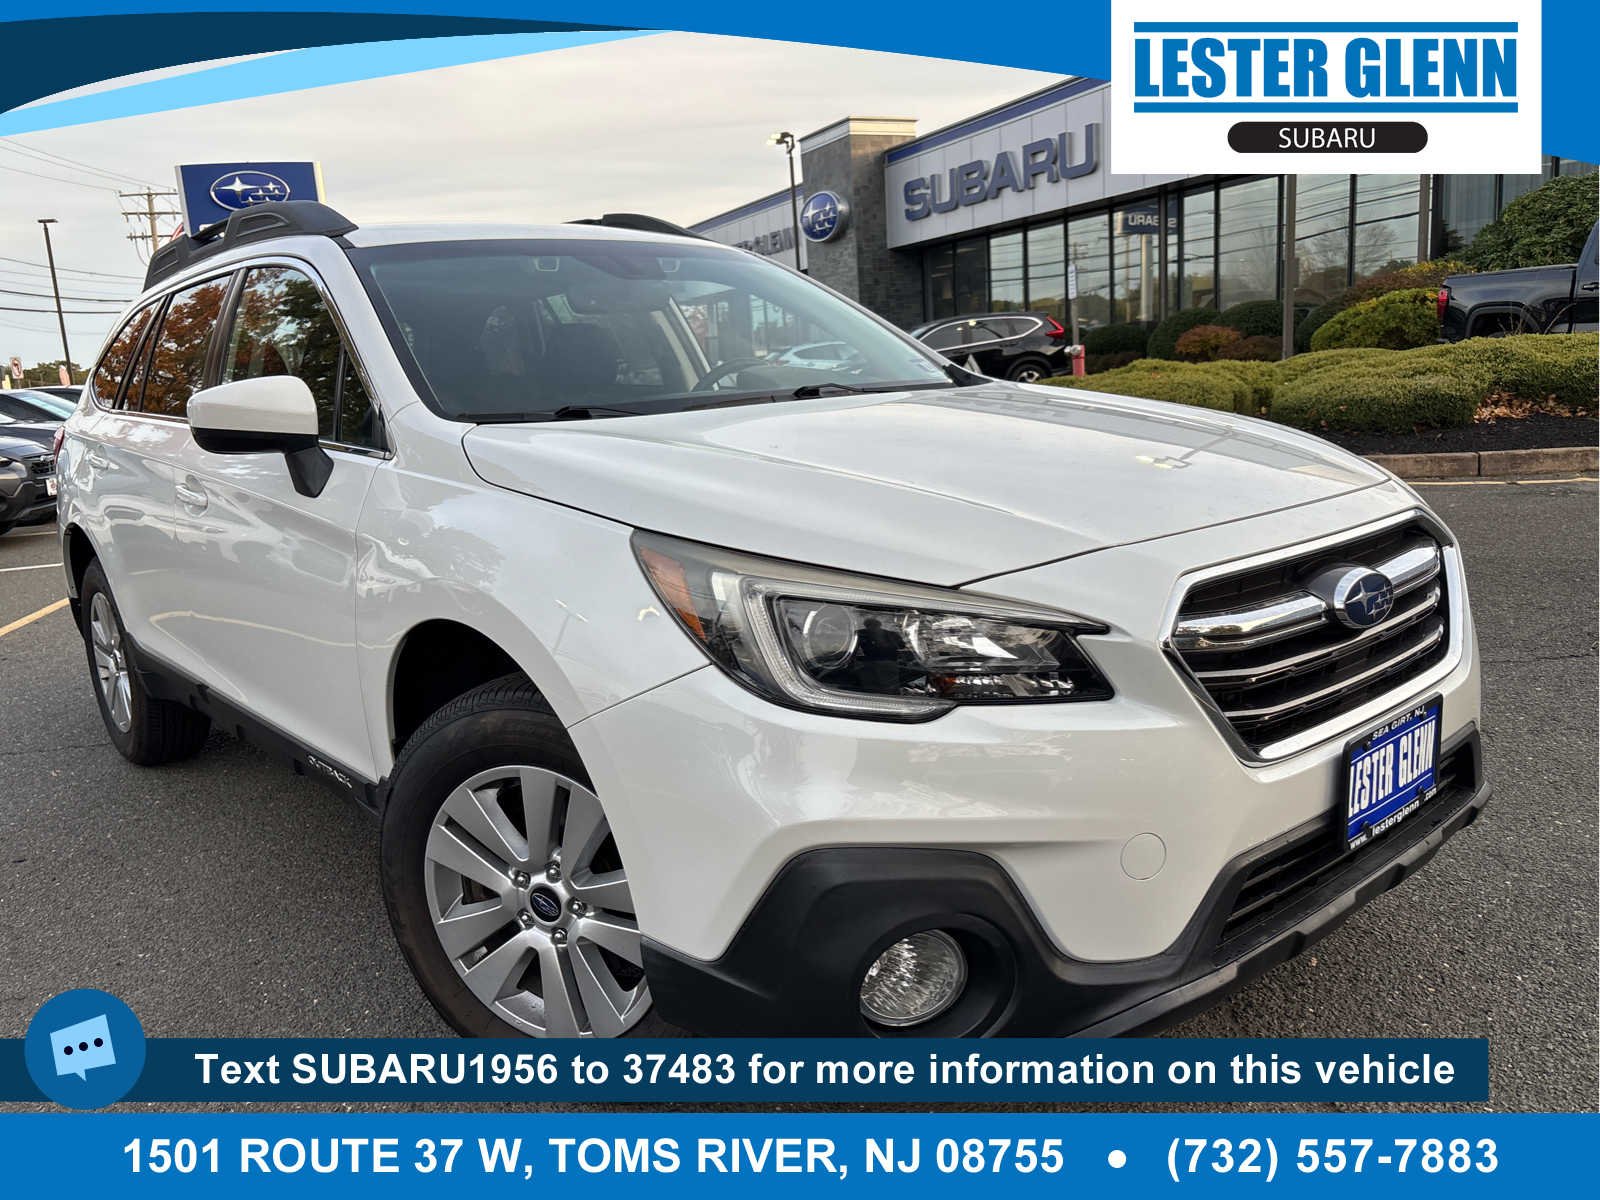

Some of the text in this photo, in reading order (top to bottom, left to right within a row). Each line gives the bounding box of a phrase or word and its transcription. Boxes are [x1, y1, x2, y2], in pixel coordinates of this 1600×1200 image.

[904, 122, 1099, 222] SUBARU
[1372, 725, 1389, 741] SEA
[1347, 719, 1436, 818] LESTER GLENN
[1372, 799, 1420, 837] lesterglenn
